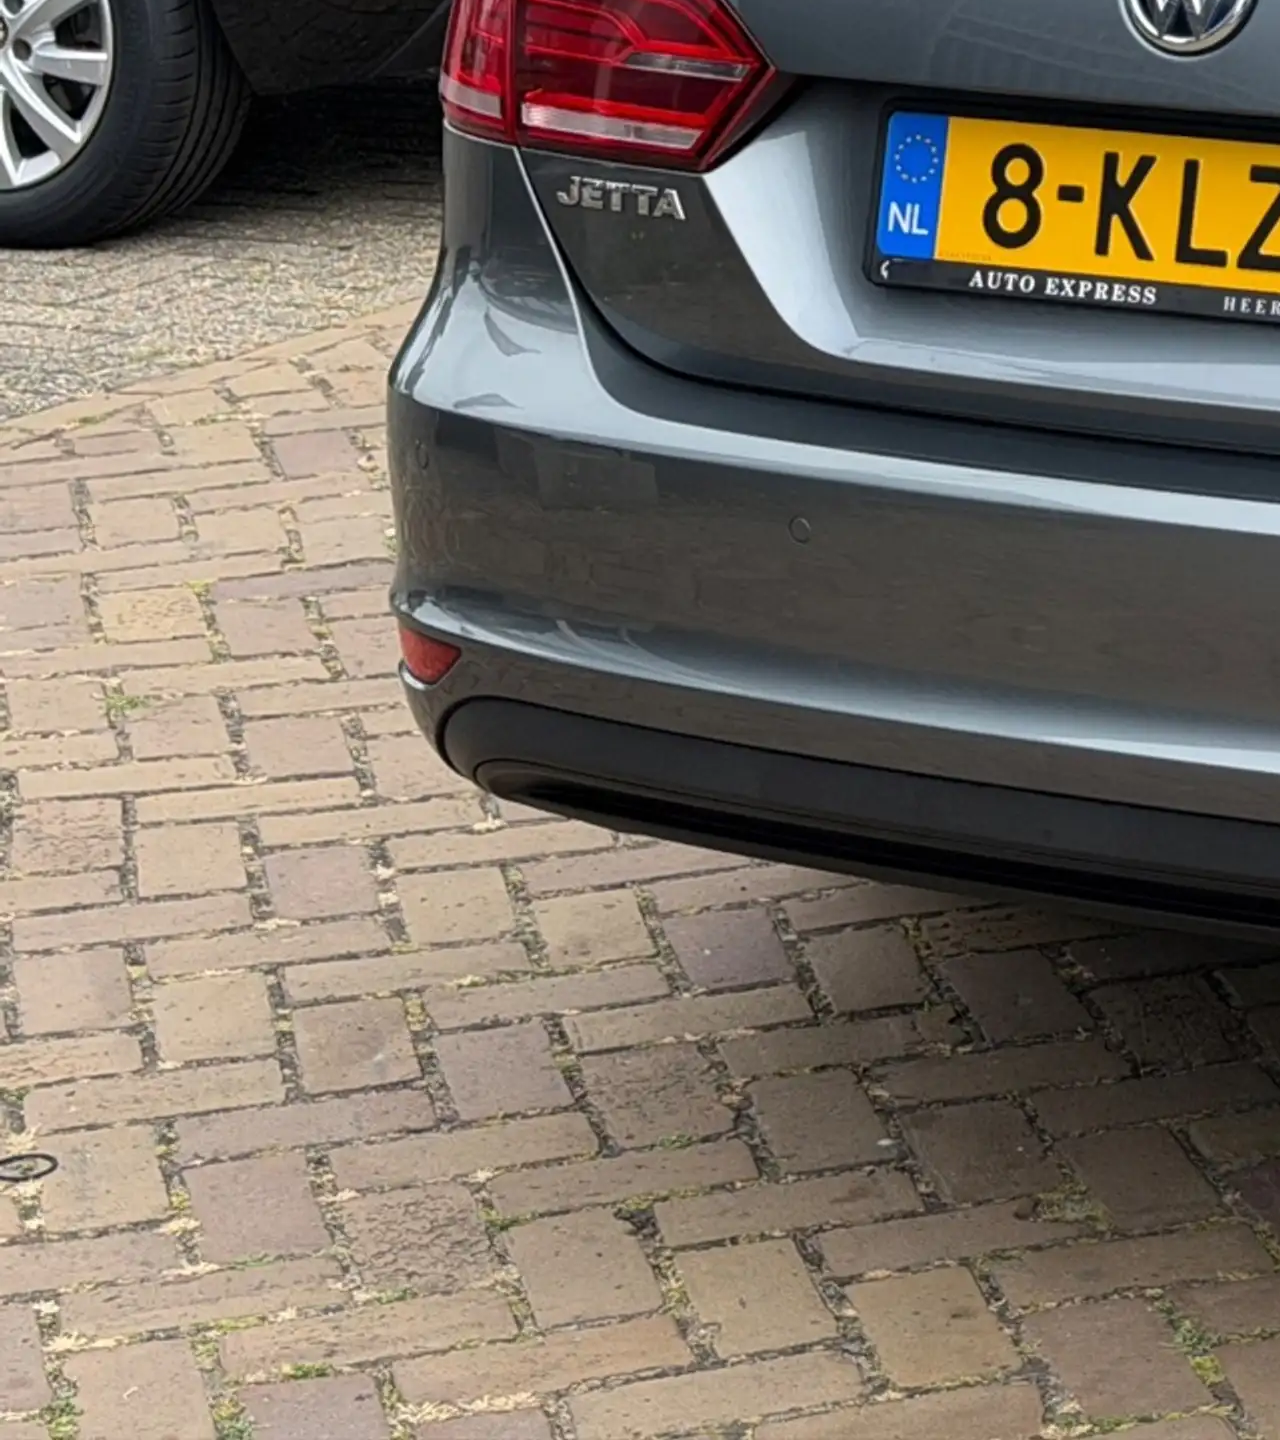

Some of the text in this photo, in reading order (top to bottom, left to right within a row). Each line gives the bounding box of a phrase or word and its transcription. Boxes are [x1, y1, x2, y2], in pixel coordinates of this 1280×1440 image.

[556, 175, 686, 220] JETTA
[887, 200, 929, 236] NL
[968, 269, 1036, 294] AUTO
[1044, 276, 1158, 305] EXPRESS
